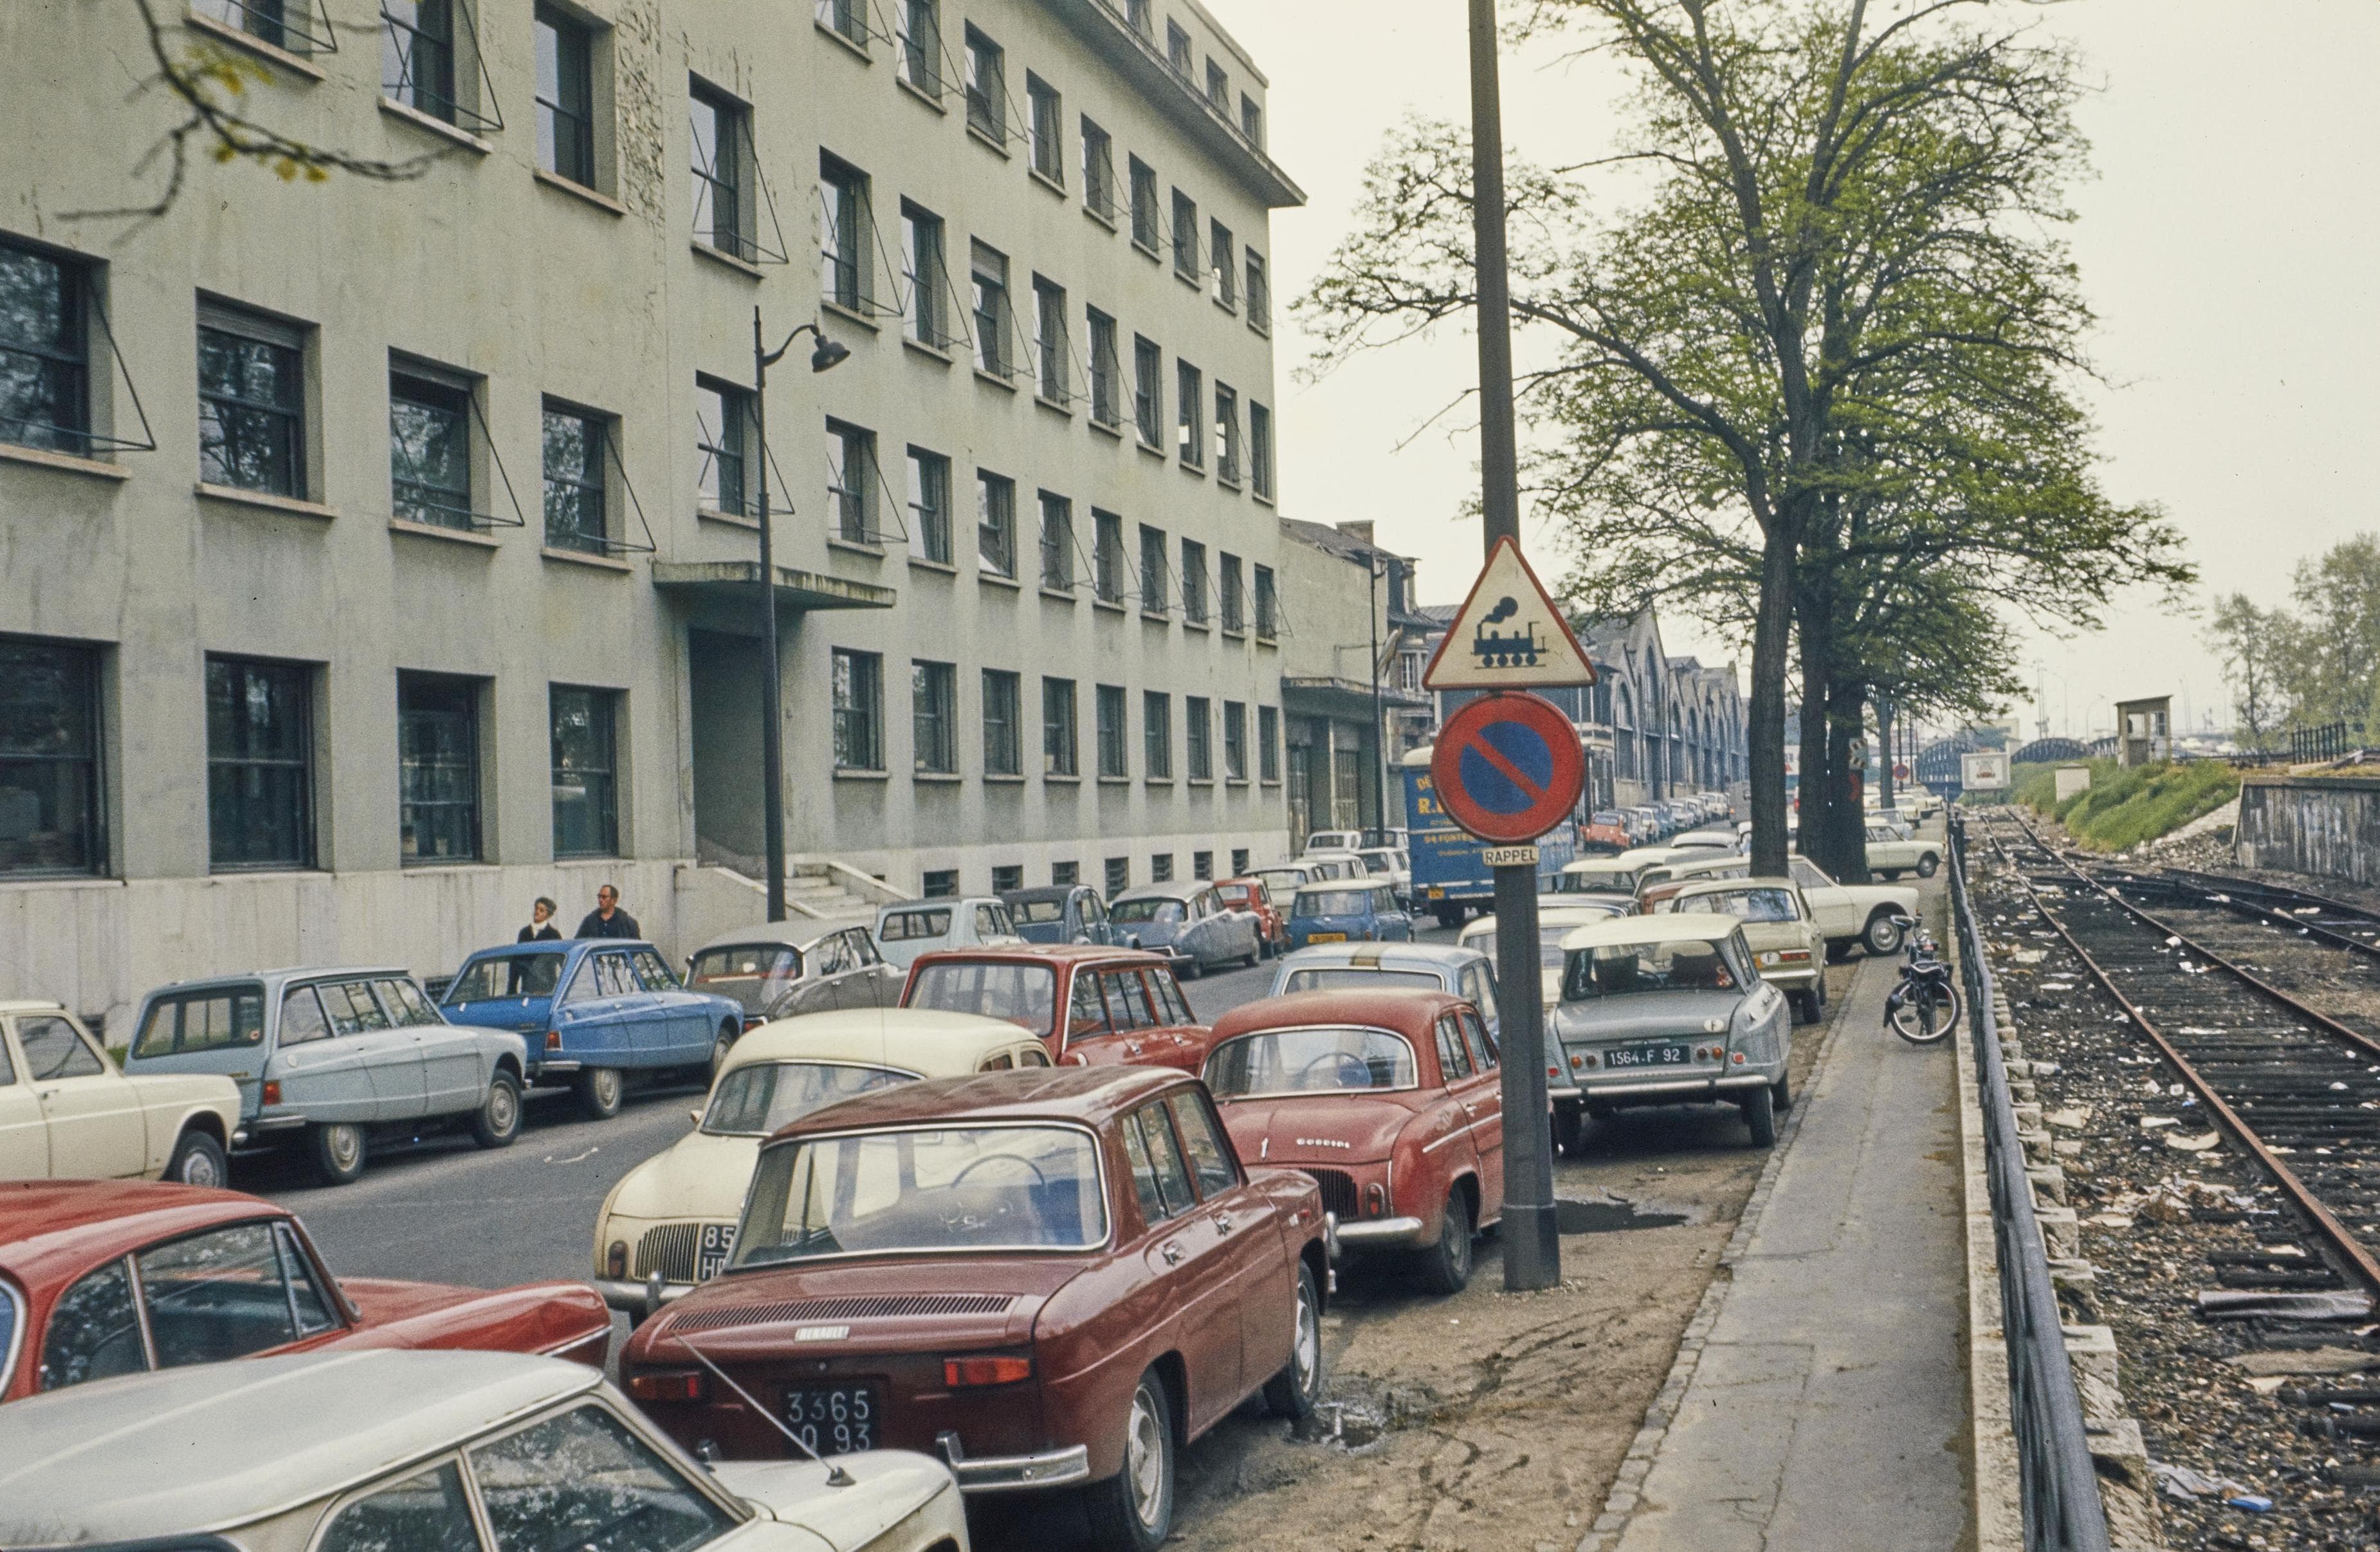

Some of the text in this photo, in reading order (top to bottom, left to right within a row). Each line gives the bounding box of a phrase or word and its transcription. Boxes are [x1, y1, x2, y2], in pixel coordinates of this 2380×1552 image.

[1485, 849, 1536, 863] RAPPEL
[1663, 1048, 1680, 1062] 92
[787, 1390, 869, 1423] 3365
[834, 1423, 870, 1453] 93
